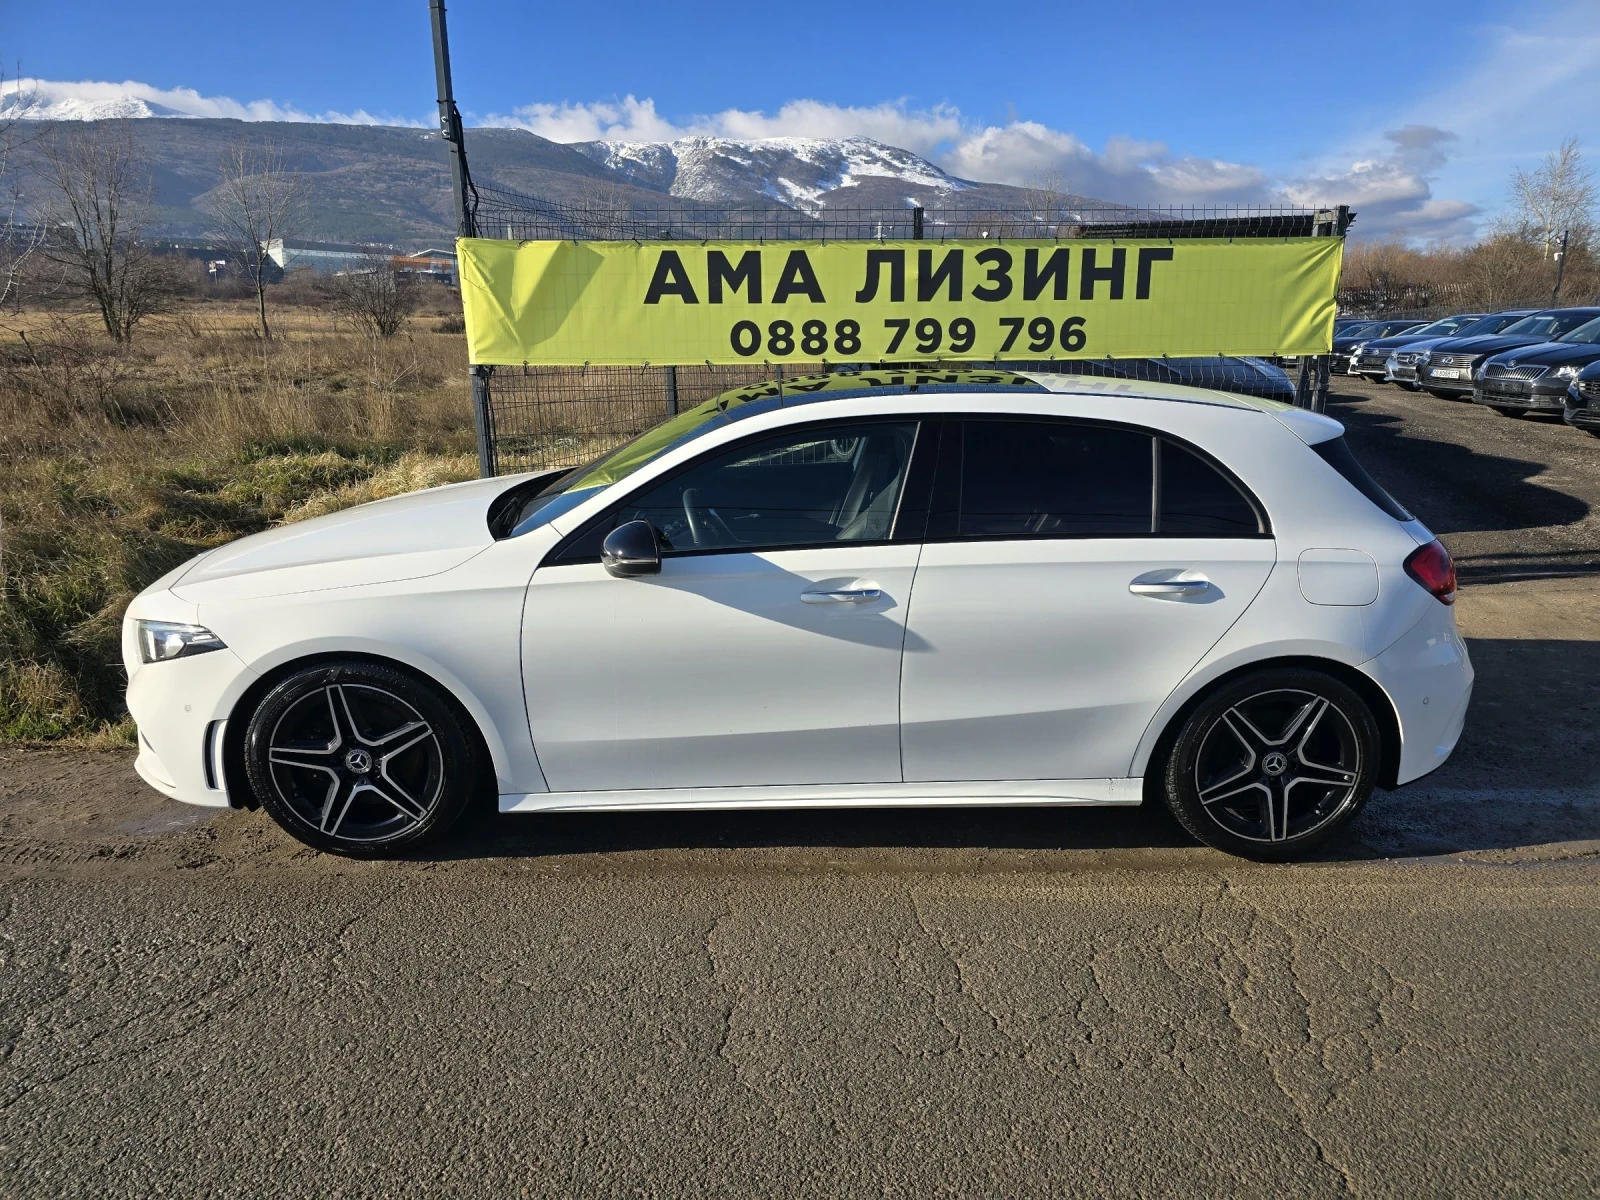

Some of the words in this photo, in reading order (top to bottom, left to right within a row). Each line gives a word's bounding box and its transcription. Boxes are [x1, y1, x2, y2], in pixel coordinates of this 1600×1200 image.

[643, 249, 827, 305] АМА
[855, 246, 1174, 304] ЛИЗИНГ
[731, 318, 862, 357] 0888
[884, 317, 976, 355] 799
[998, 316, 1087, 353] 796
